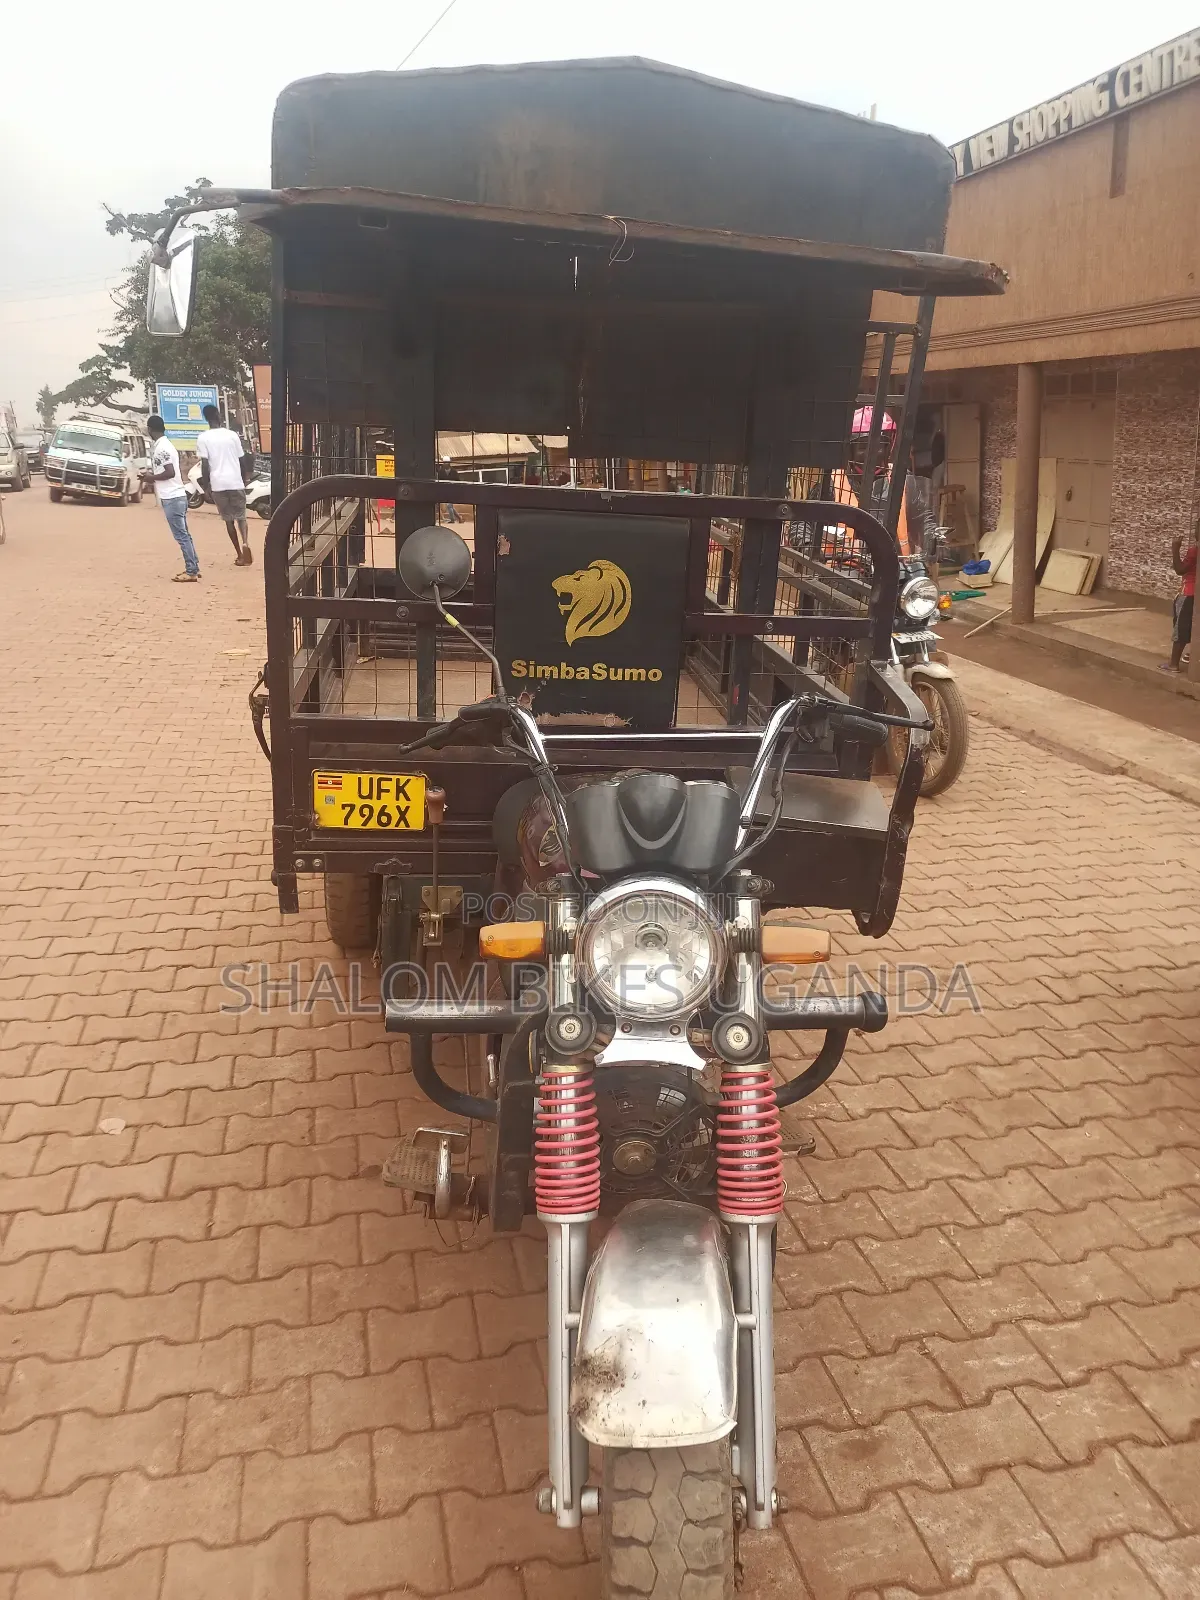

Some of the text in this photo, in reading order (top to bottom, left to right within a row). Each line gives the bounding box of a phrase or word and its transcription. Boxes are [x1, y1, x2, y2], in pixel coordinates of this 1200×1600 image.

[969, 122, 1009, 171] VIEW
[1012, 73, 1110, 153] SHOPPING
[1115, 32, 1200, 108] CENTRE
[163, 390, 187, 398] GOLDEN
[510, 659, 663, 682] SimbaSumo
[357, 776, 411, 802] UFK
[341, 803, 411, 828] 796X
